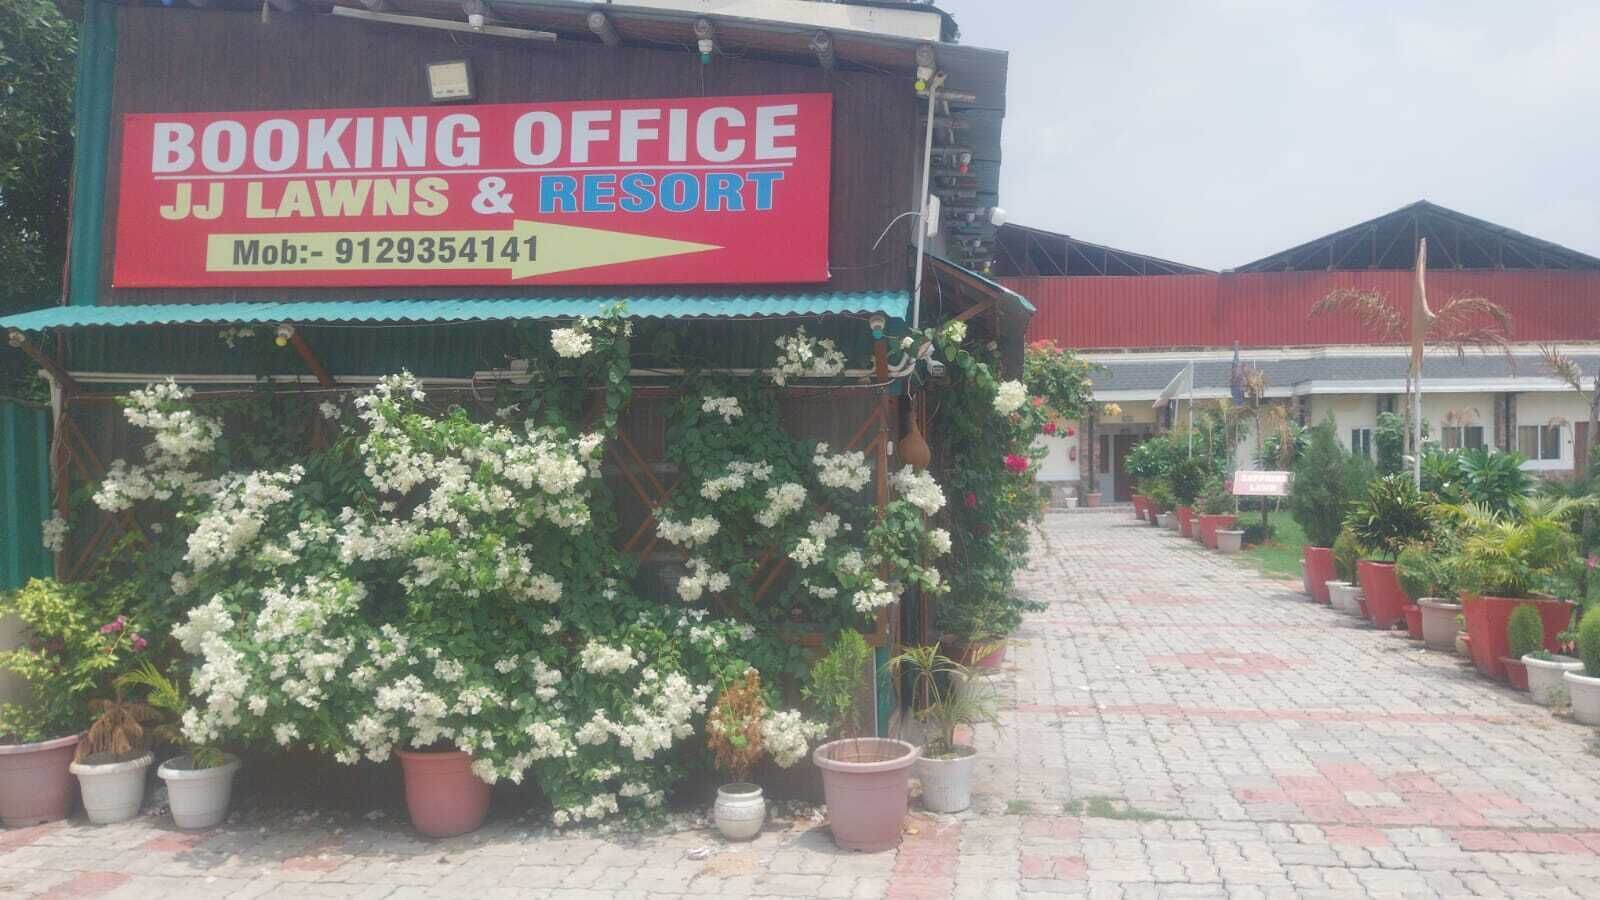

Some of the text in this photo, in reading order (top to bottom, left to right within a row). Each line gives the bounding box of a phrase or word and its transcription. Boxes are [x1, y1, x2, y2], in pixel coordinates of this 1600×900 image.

[152, 104, 798, 173] BOOKING OFFICE
[160, 171, 785, 219] JJ LAWNS & RESORT
[232, 236, 537, 265] Mob:- 9129354141
